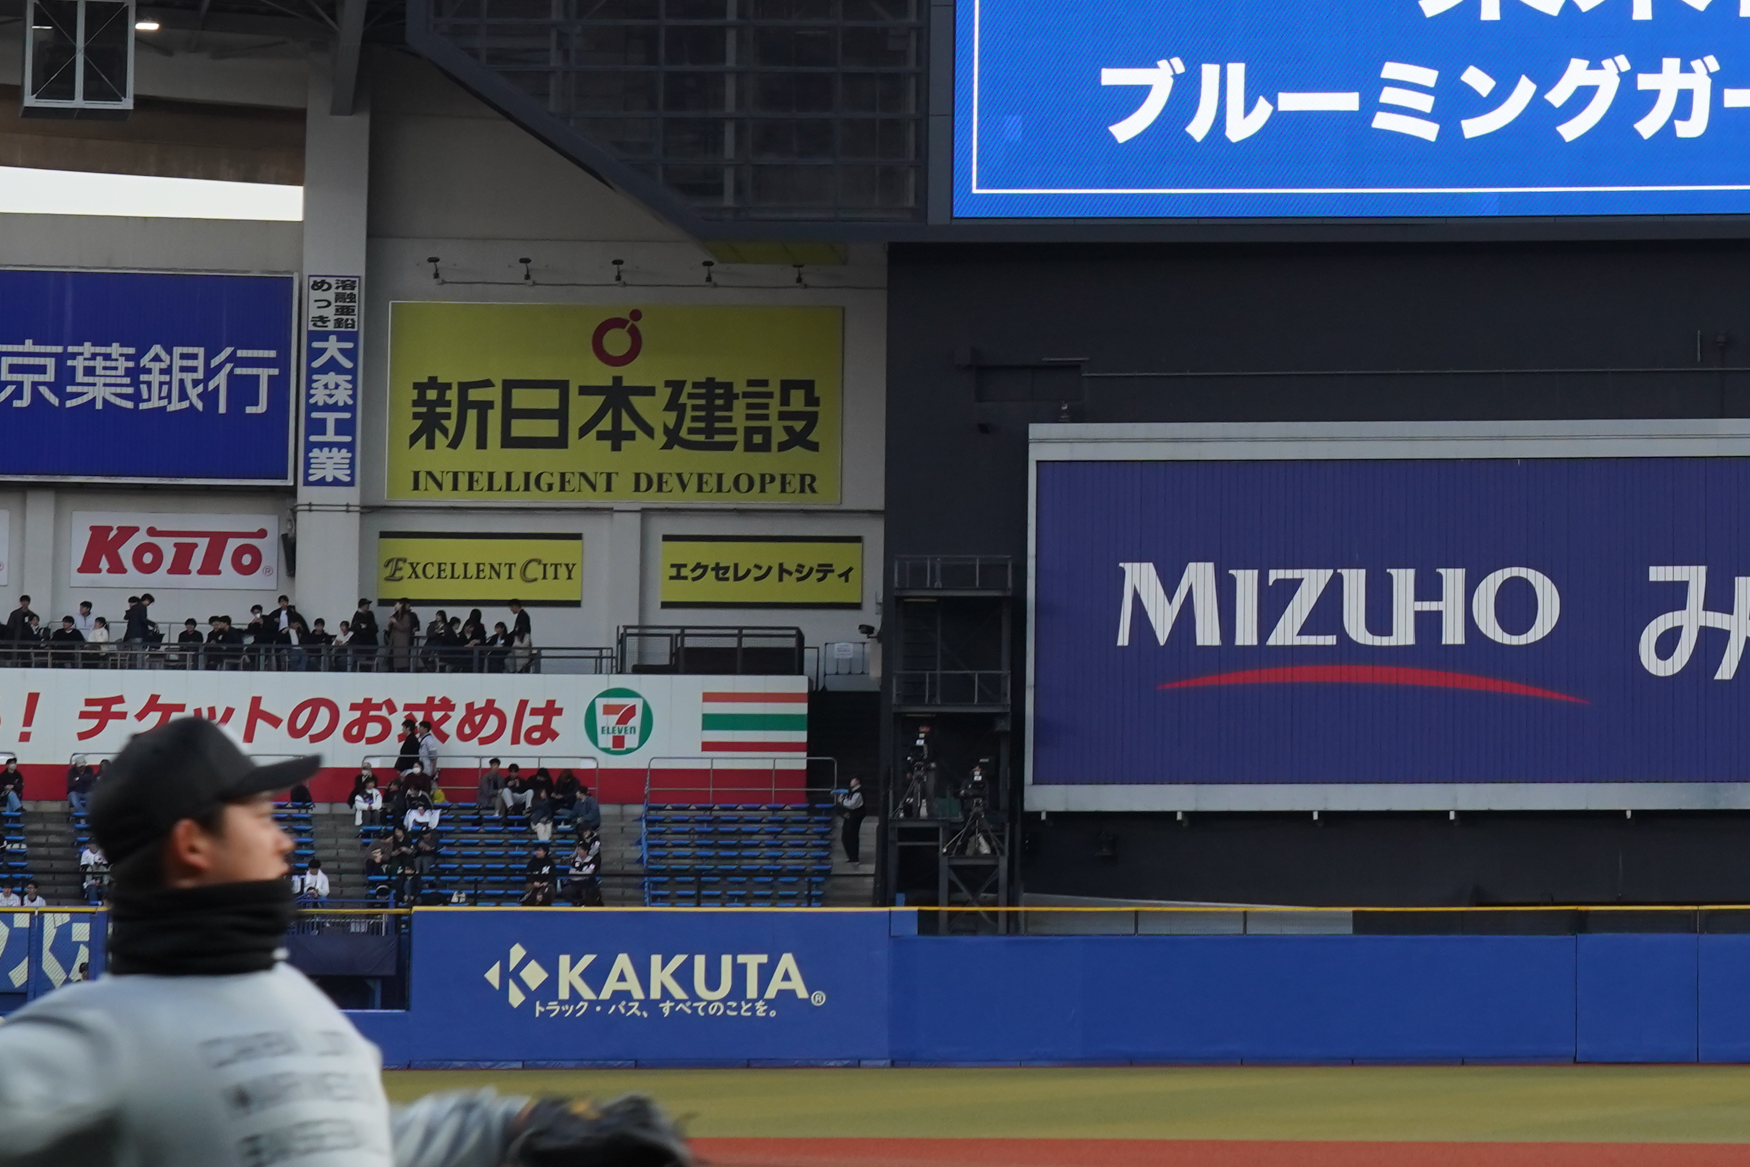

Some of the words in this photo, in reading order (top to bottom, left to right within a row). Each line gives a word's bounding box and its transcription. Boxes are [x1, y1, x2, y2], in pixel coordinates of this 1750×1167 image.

[310, 279, 333, 328] めっき
[333, 278, 357, 330] 溶融亜鉛
[0, 338, 280, 414] 京葉銀行
[308, 334, 355, 483] 大森工業
[409, 376, 821, 453] 新日本建設
[411, 470, 620, 494] INTELLIGENT
[632, 471, 819, 495] DEVELOPER
[384, 556, 517, 583] EXCELLENT
[520, 557, 577, 584] CITY
[668, 561, 855, 584] エクセレントシティ
[1116, 561, 1561, 647] MIZUHO
[558, 952, 809, 1000] KAKUTA
